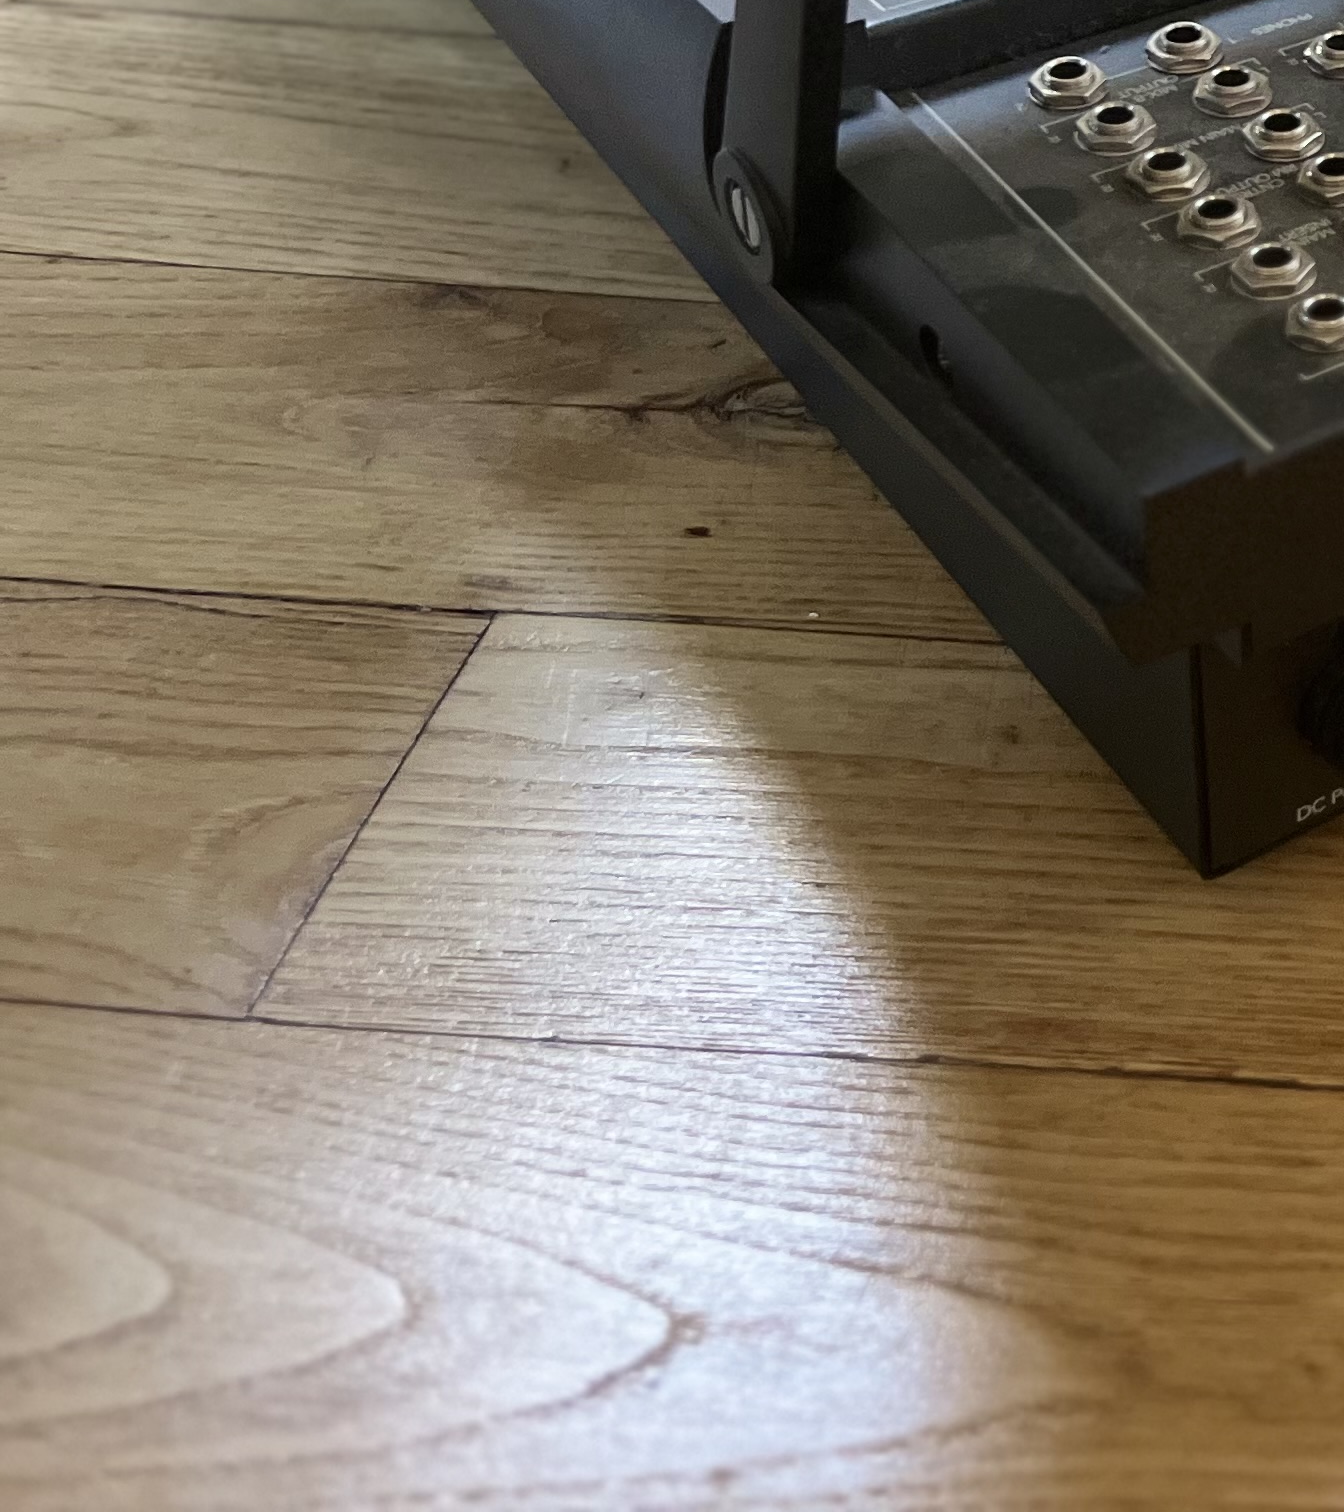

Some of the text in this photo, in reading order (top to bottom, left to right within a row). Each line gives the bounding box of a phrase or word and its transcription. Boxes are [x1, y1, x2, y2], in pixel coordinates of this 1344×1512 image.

[1251, 13, 1313, 35] PHONES
[1119, 75, 1179, 99] OUTPUT
[1296, 795, 1327, 822] DC
